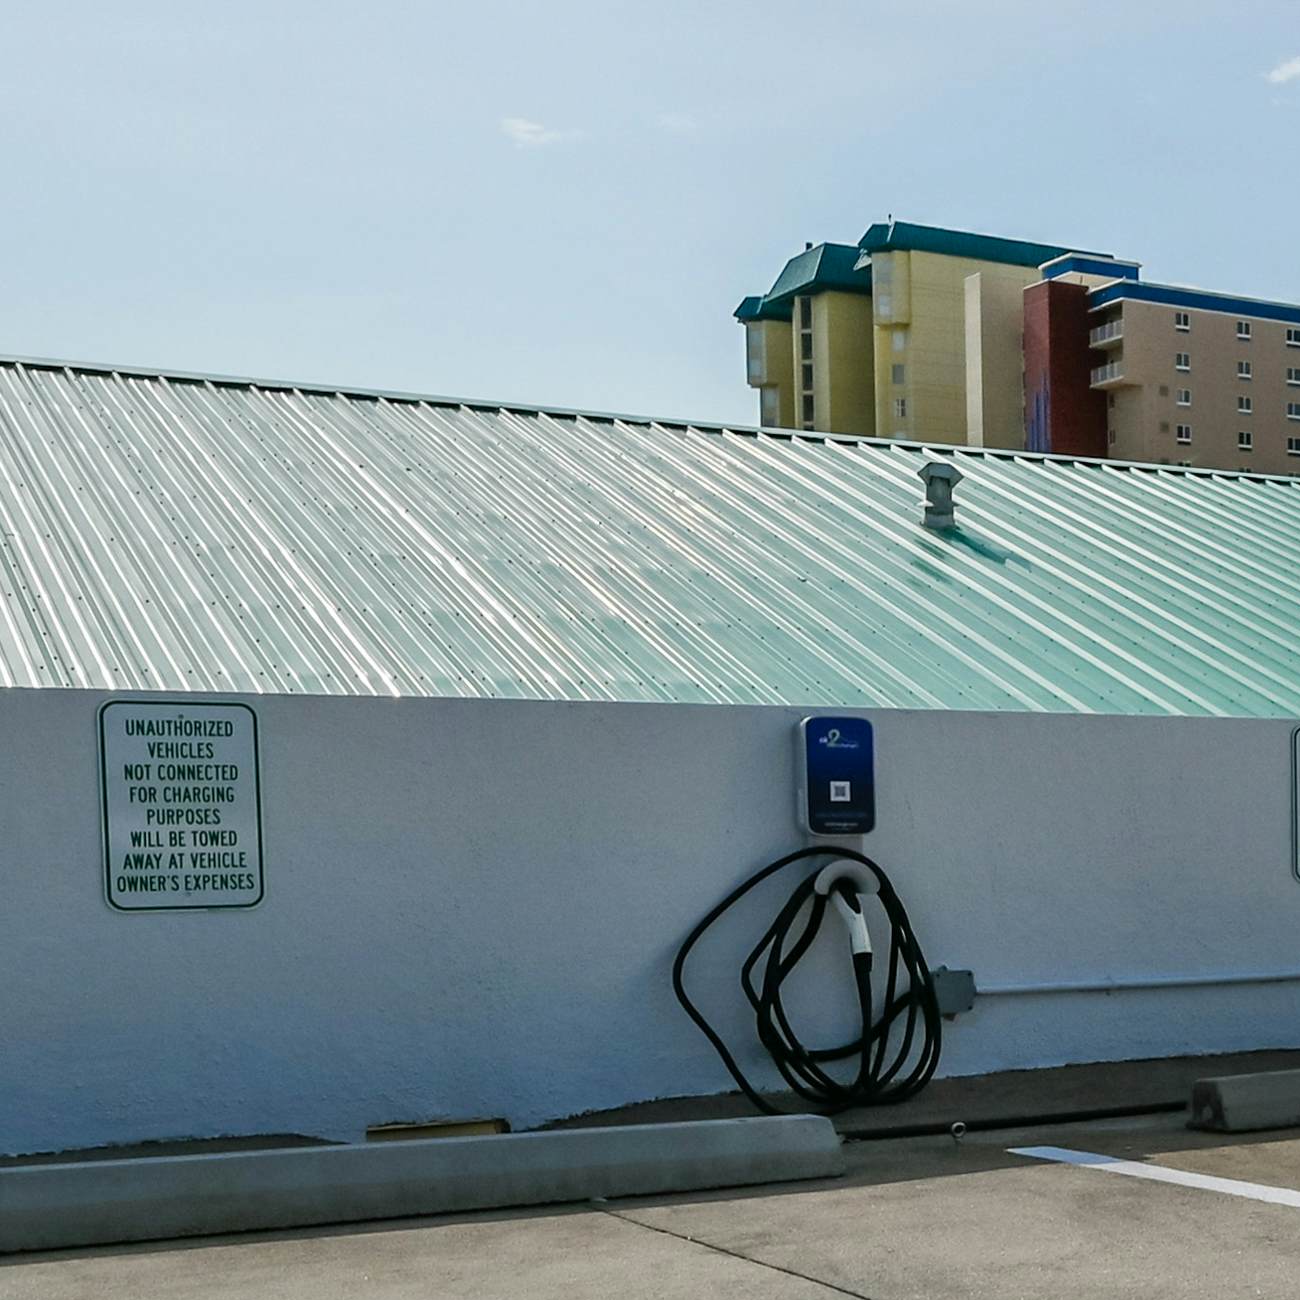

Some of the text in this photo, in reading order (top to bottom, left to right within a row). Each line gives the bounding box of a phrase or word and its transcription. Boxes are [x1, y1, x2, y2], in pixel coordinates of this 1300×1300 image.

[126, 719, 233, 737] UNAUTHORIZED
[148, 742, 214, 759] VEHICLES
[124, 764, 238, 781] NOT CONNECTED
[130, 786, 234, 803] FOR CHARGING
[147, 809, 221, 825] PURPOSES
[130, 830, 237, 847] WILL BE TOWED
[123, 852, 247, 870] AWAY AT VEHICLE
[117, 873, 255, 892] OWNER'S EXPENSES
